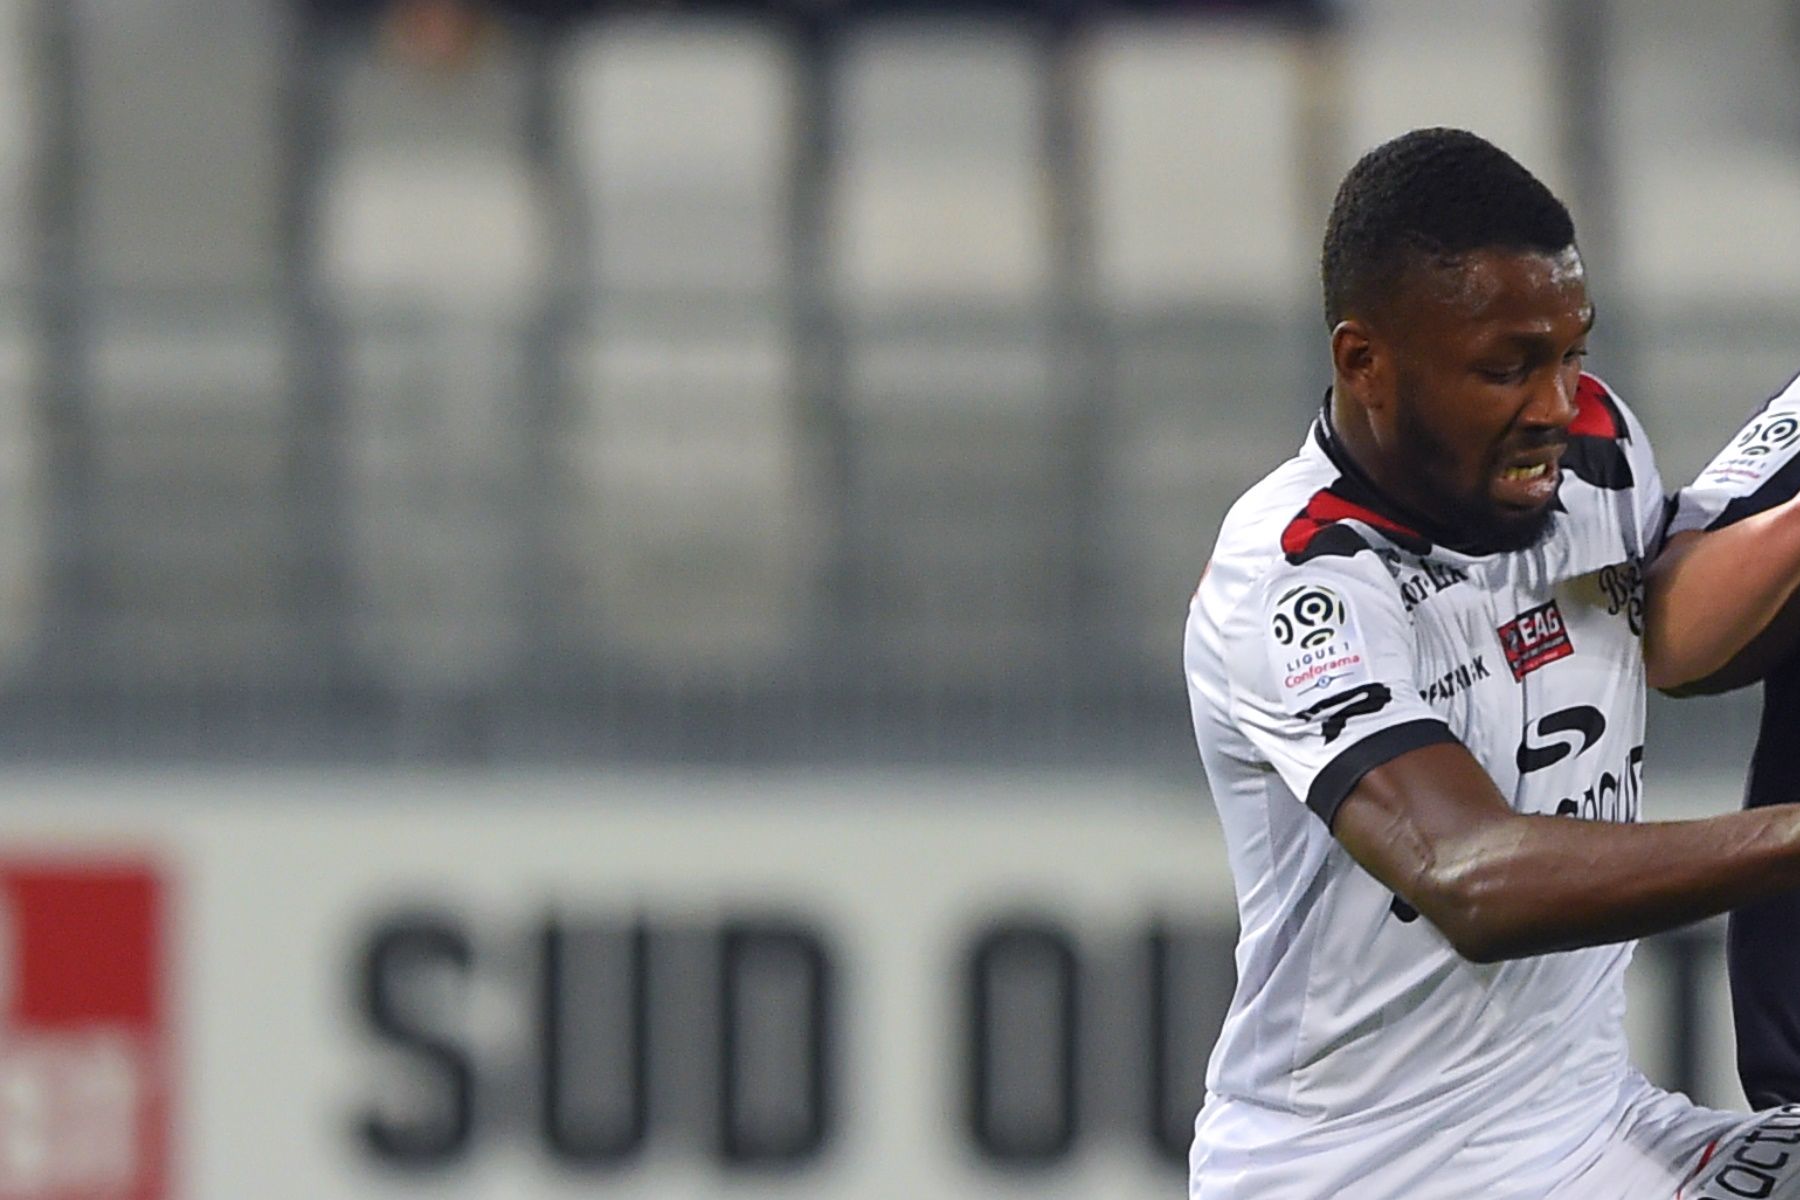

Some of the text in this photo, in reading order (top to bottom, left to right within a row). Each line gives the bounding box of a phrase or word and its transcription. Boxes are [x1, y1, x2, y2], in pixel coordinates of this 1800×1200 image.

[1518, 606, 1561, 647] EAG
[1284, 654, 1361, 688] Conforama
[352, 900, 852, 1180] SUD
